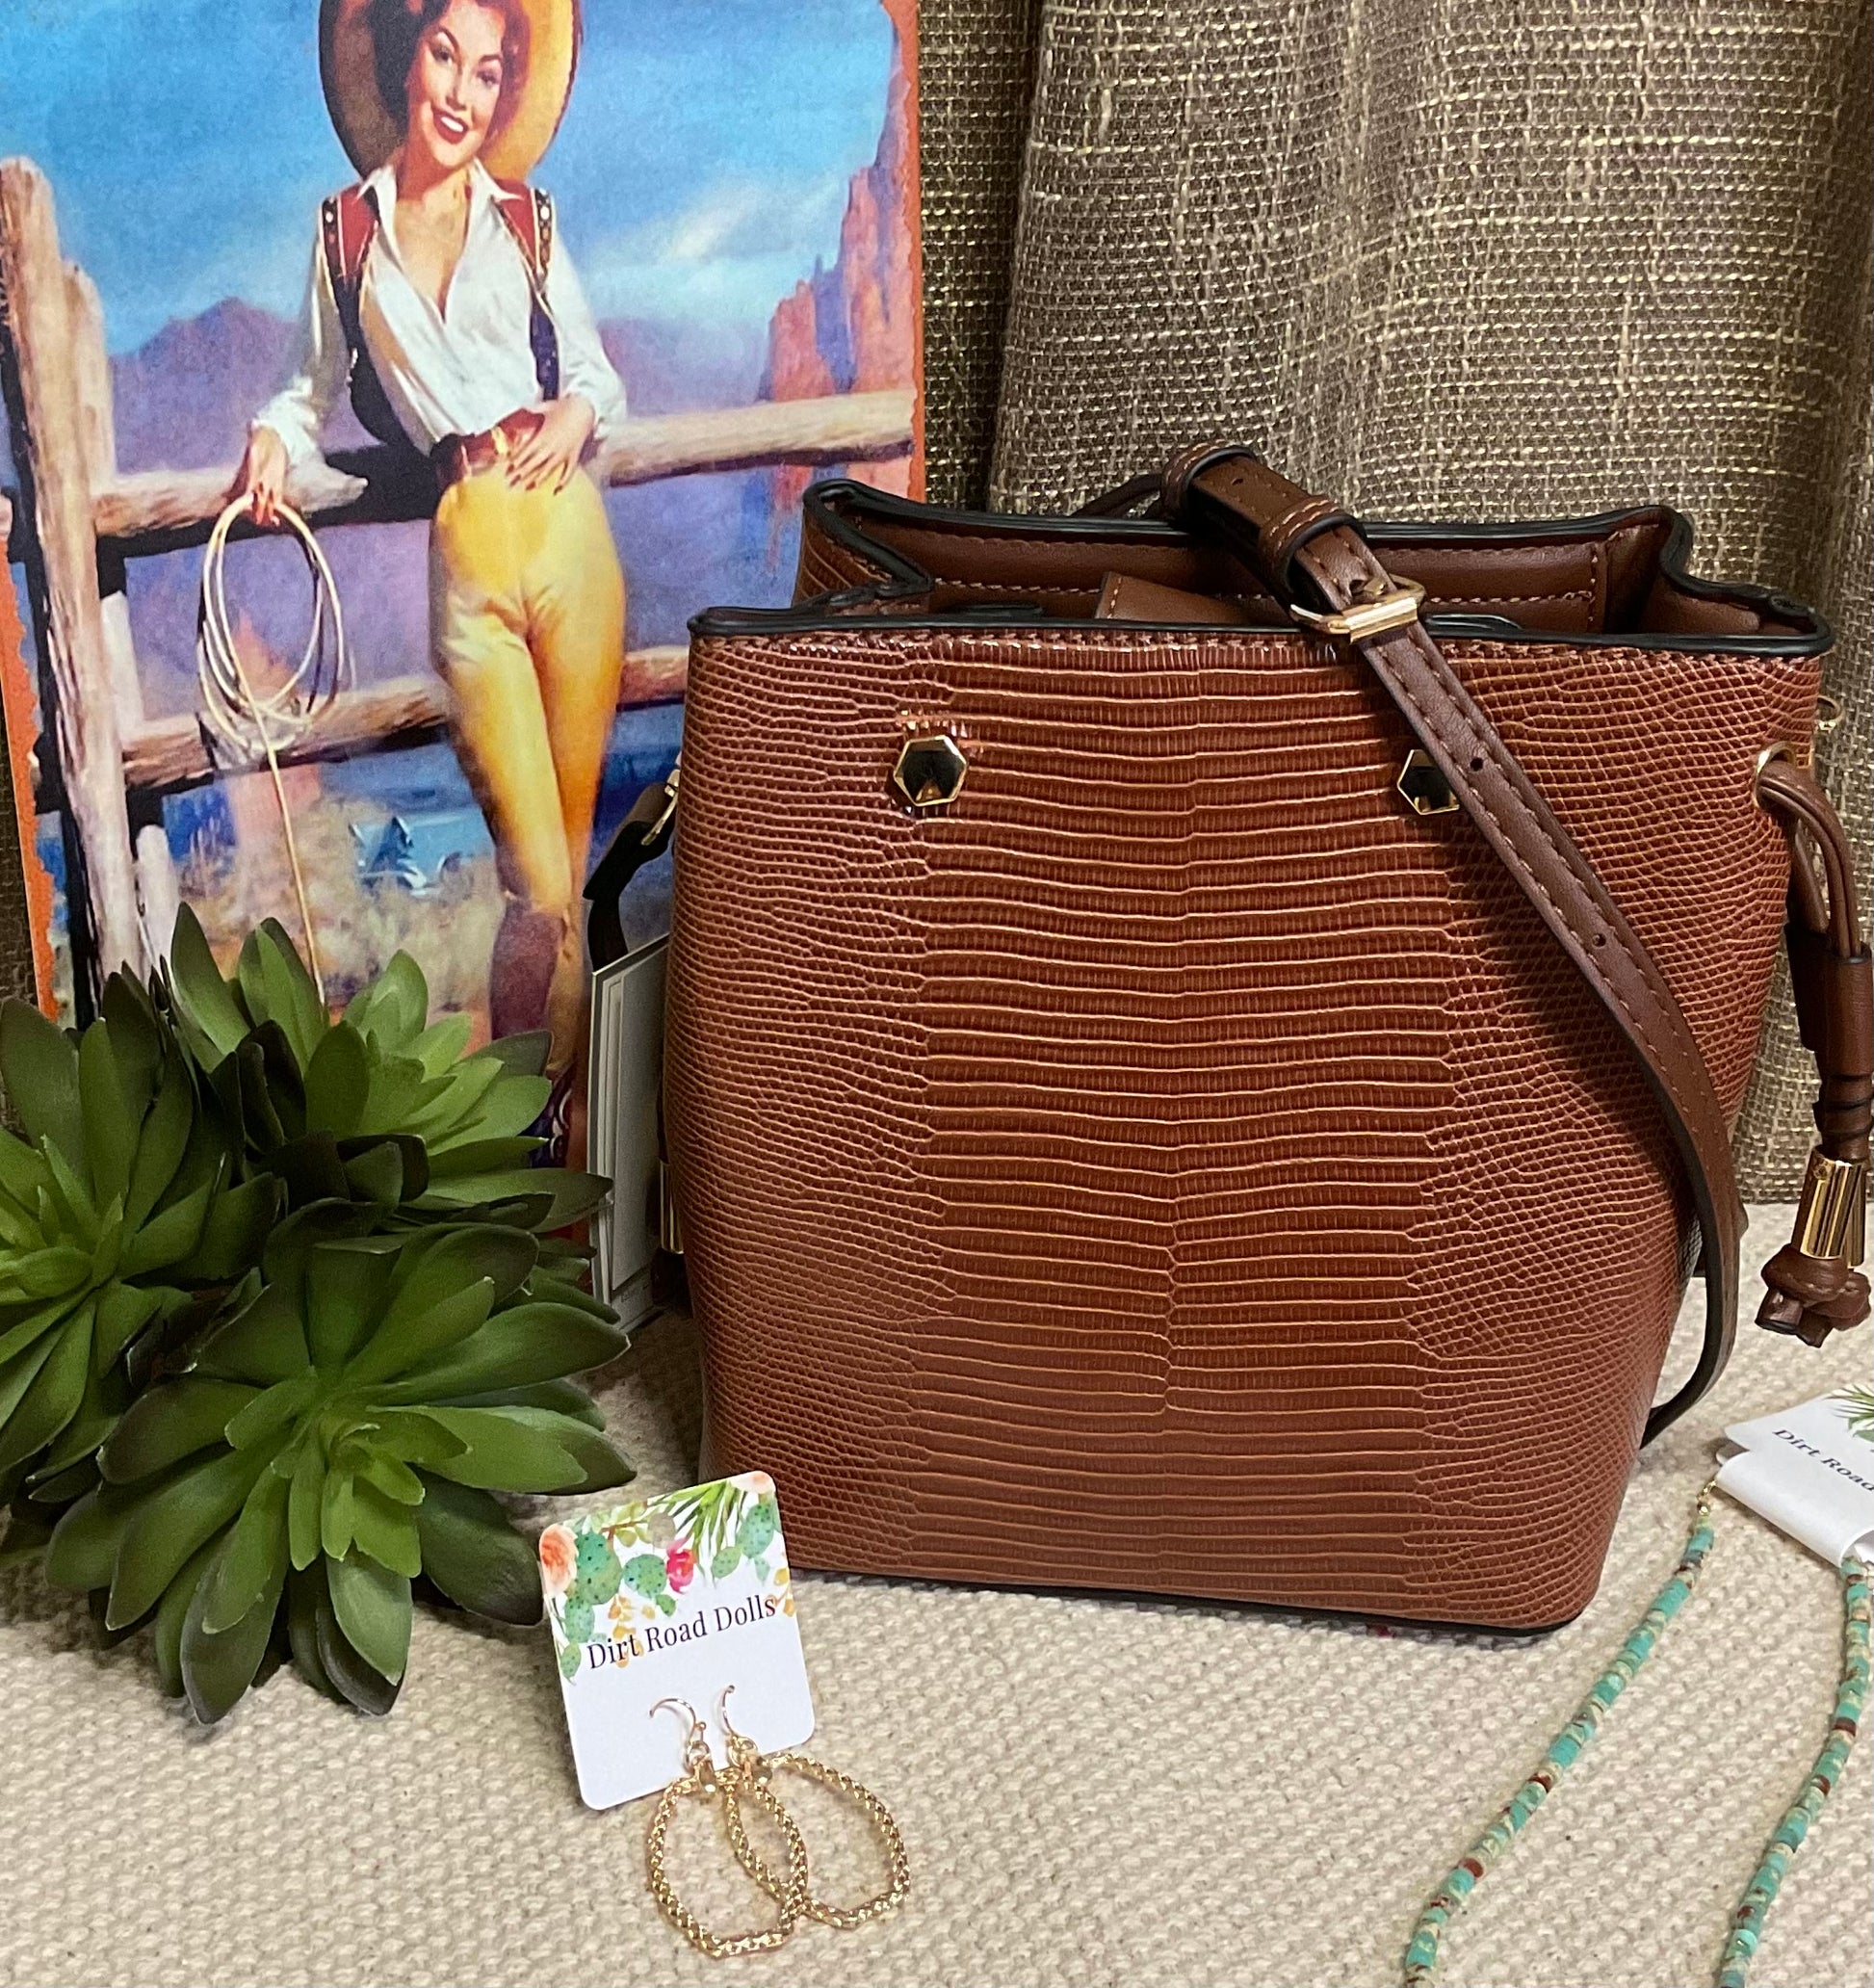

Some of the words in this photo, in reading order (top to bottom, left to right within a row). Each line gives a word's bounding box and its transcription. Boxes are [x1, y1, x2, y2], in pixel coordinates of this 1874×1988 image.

[1772, 1429, 1821, 1457] Dirt
[586, 1634, 640, 1669] Dirt
[644, 1610, 708, 1653] Road
[714, 1594, 776, 1632] Dolls
